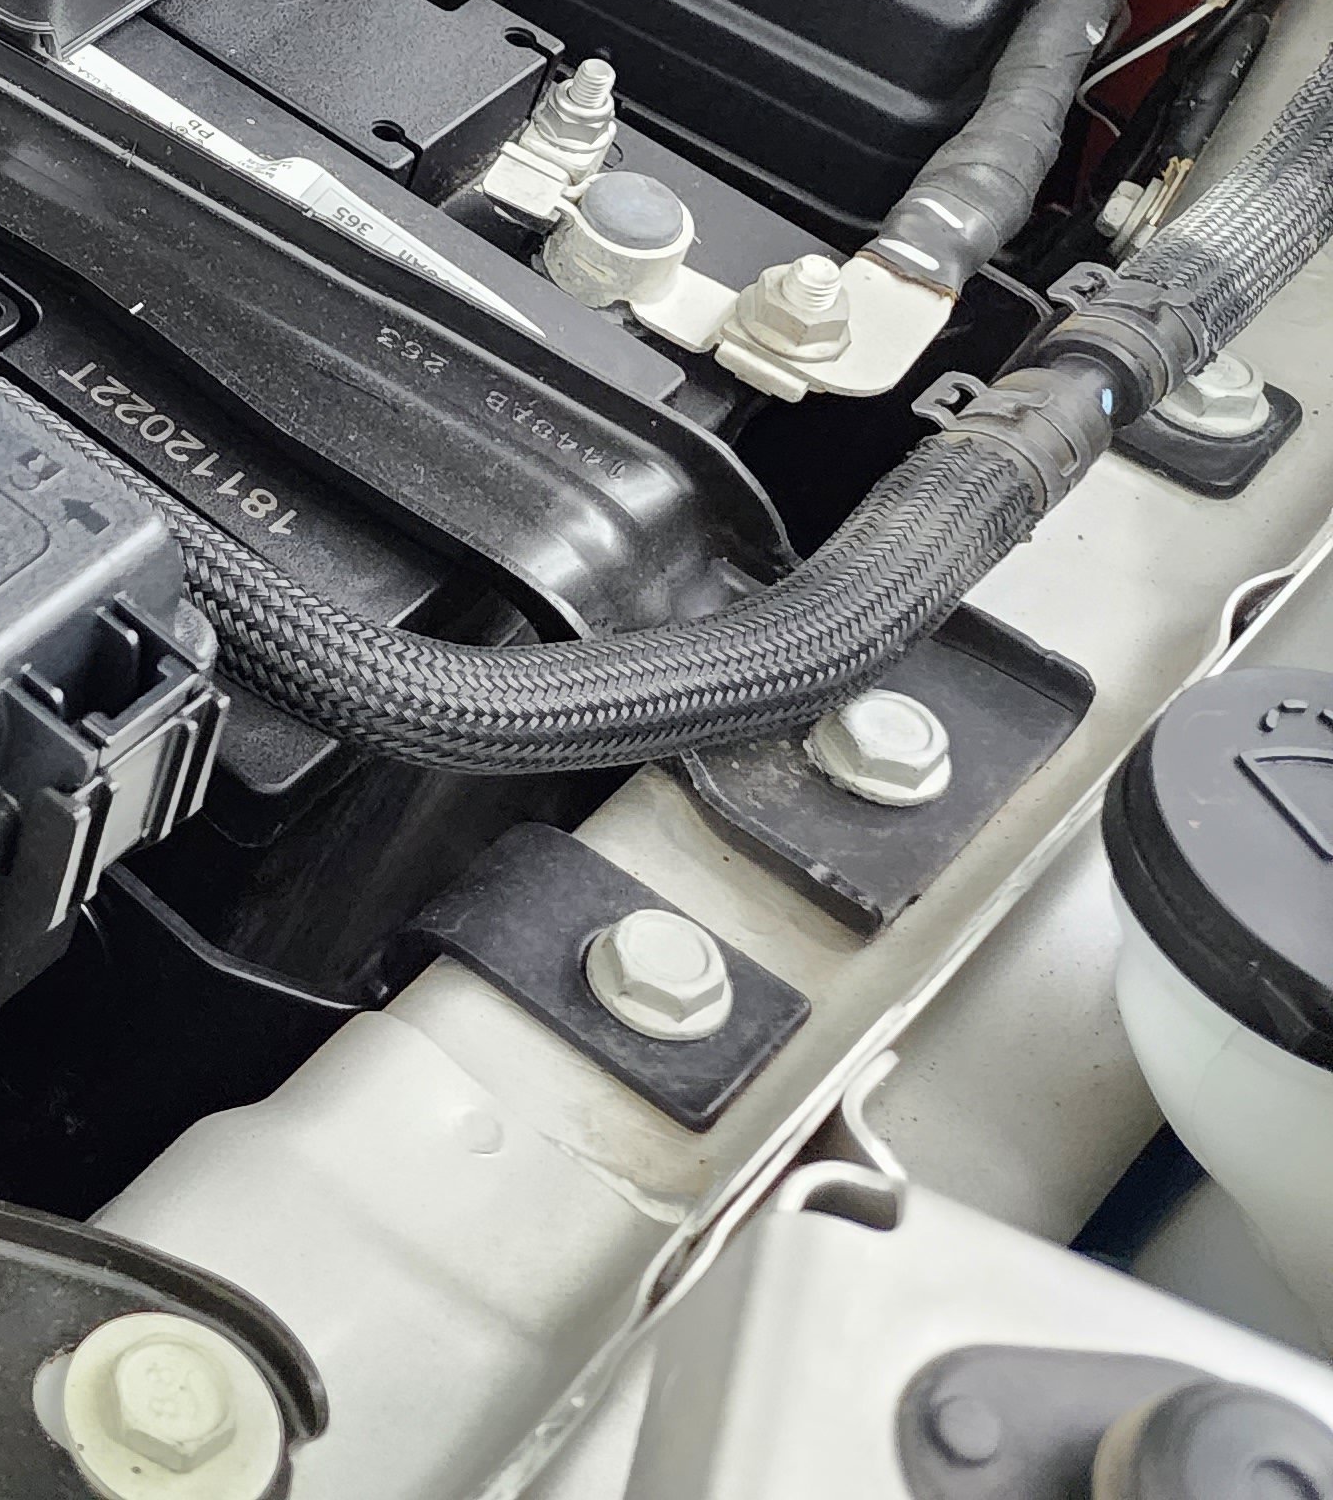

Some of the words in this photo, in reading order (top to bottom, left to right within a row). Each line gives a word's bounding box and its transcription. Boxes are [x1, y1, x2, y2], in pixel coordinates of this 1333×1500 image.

[187, 119, 215, 140] Pb
[332, 206, 374, 237] 365
[57, 361, 298, 536] 18112022T
